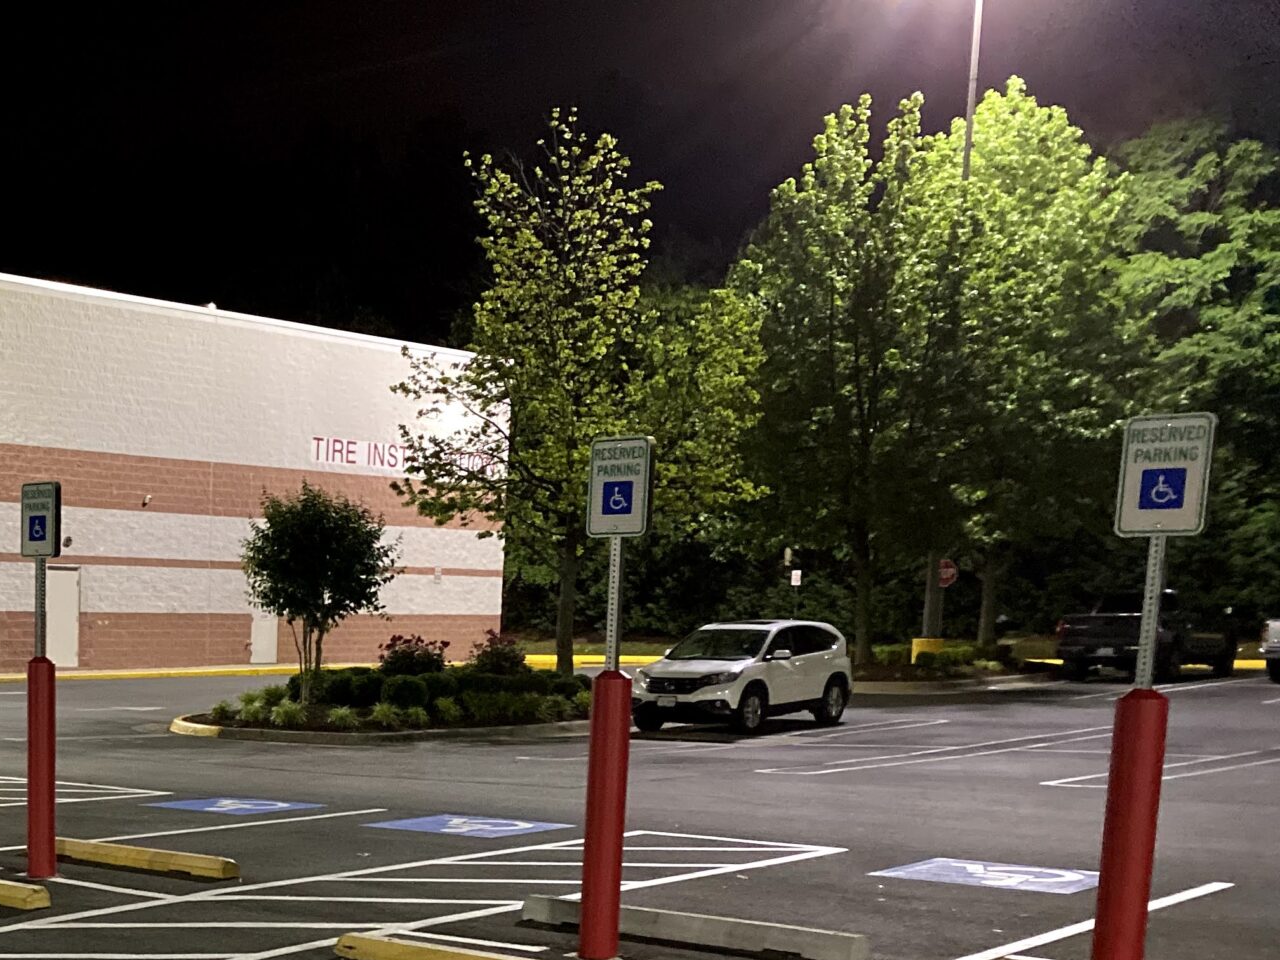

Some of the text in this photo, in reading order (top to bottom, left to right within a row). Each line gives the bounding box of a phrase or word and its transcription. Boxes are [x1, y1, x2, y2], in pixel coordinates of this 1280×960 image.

[1131, 425, 1206, 443] RESERVED
[313, 437, 357, 464] TIRE
[594, 446, 645, 461] RESERVED
[1134, 446, 1199, 463] PARKING
[597, 463, 640, 477] PARKING
